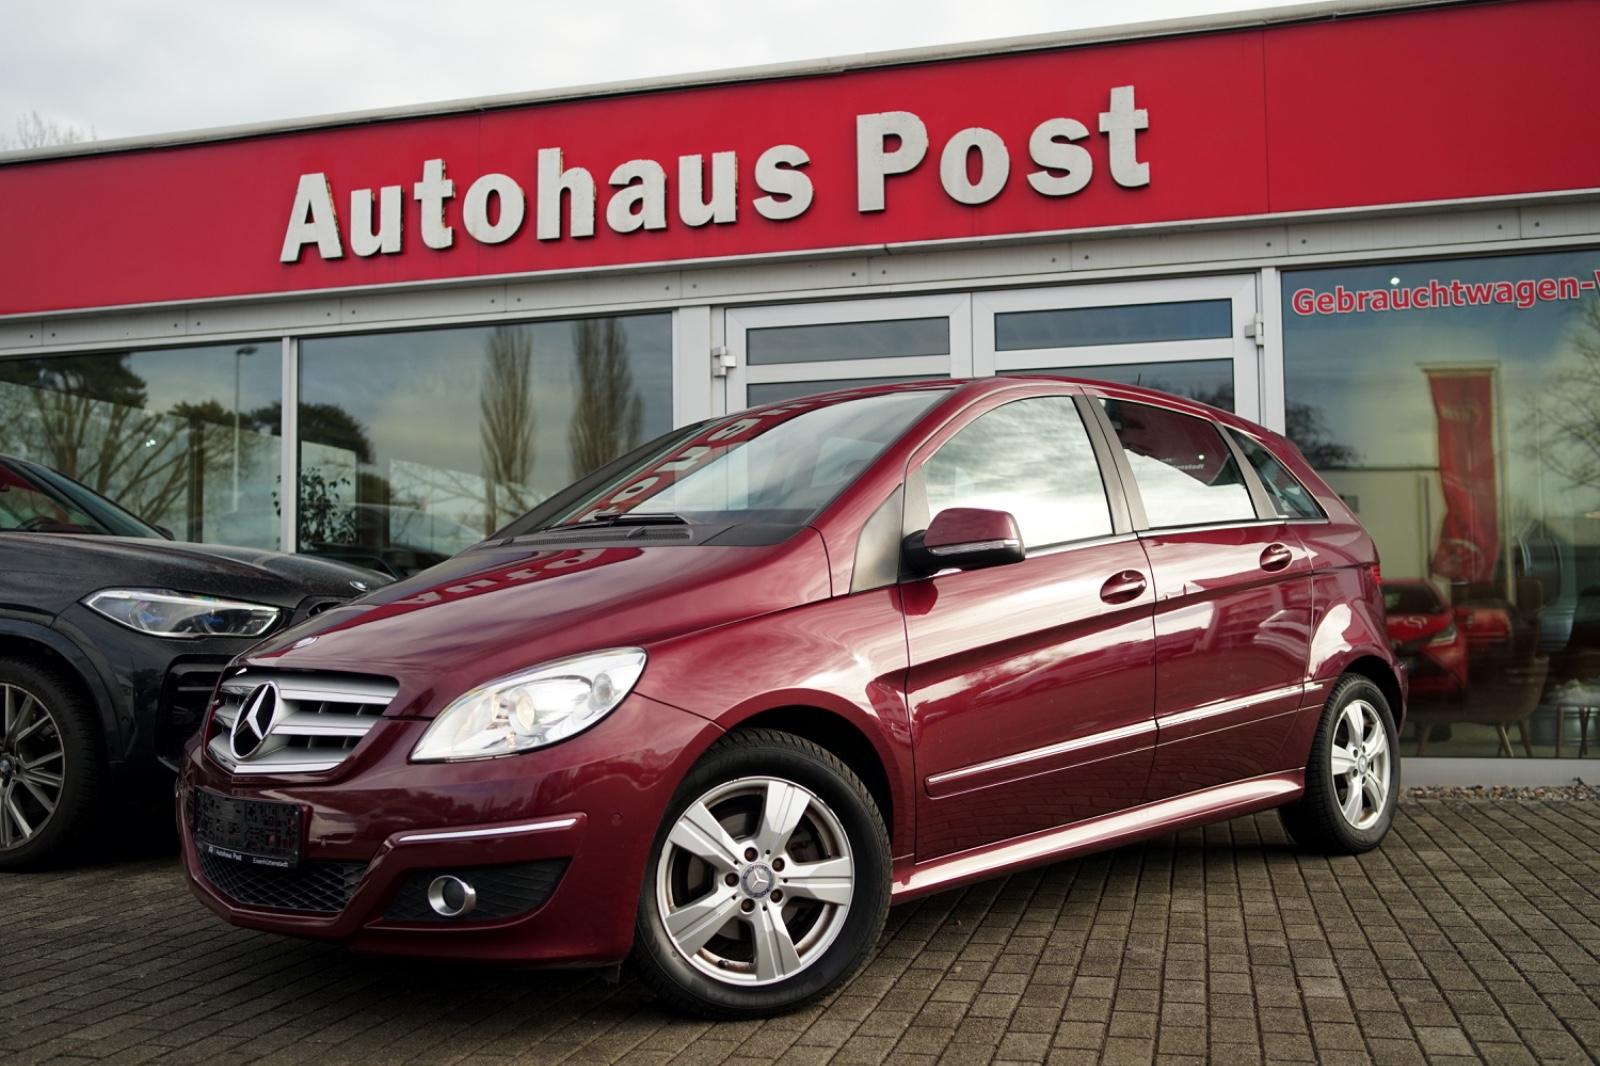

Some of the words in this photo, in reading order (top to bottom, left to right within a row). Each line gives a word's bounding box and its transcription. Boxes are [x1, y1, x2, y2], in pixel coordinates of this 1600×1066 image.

[279, 145, 814, 263] Autohaus
[857, 85, 1150, 212] Post
[1292, 269, 1600, 315] Gebrauchtwagen-
